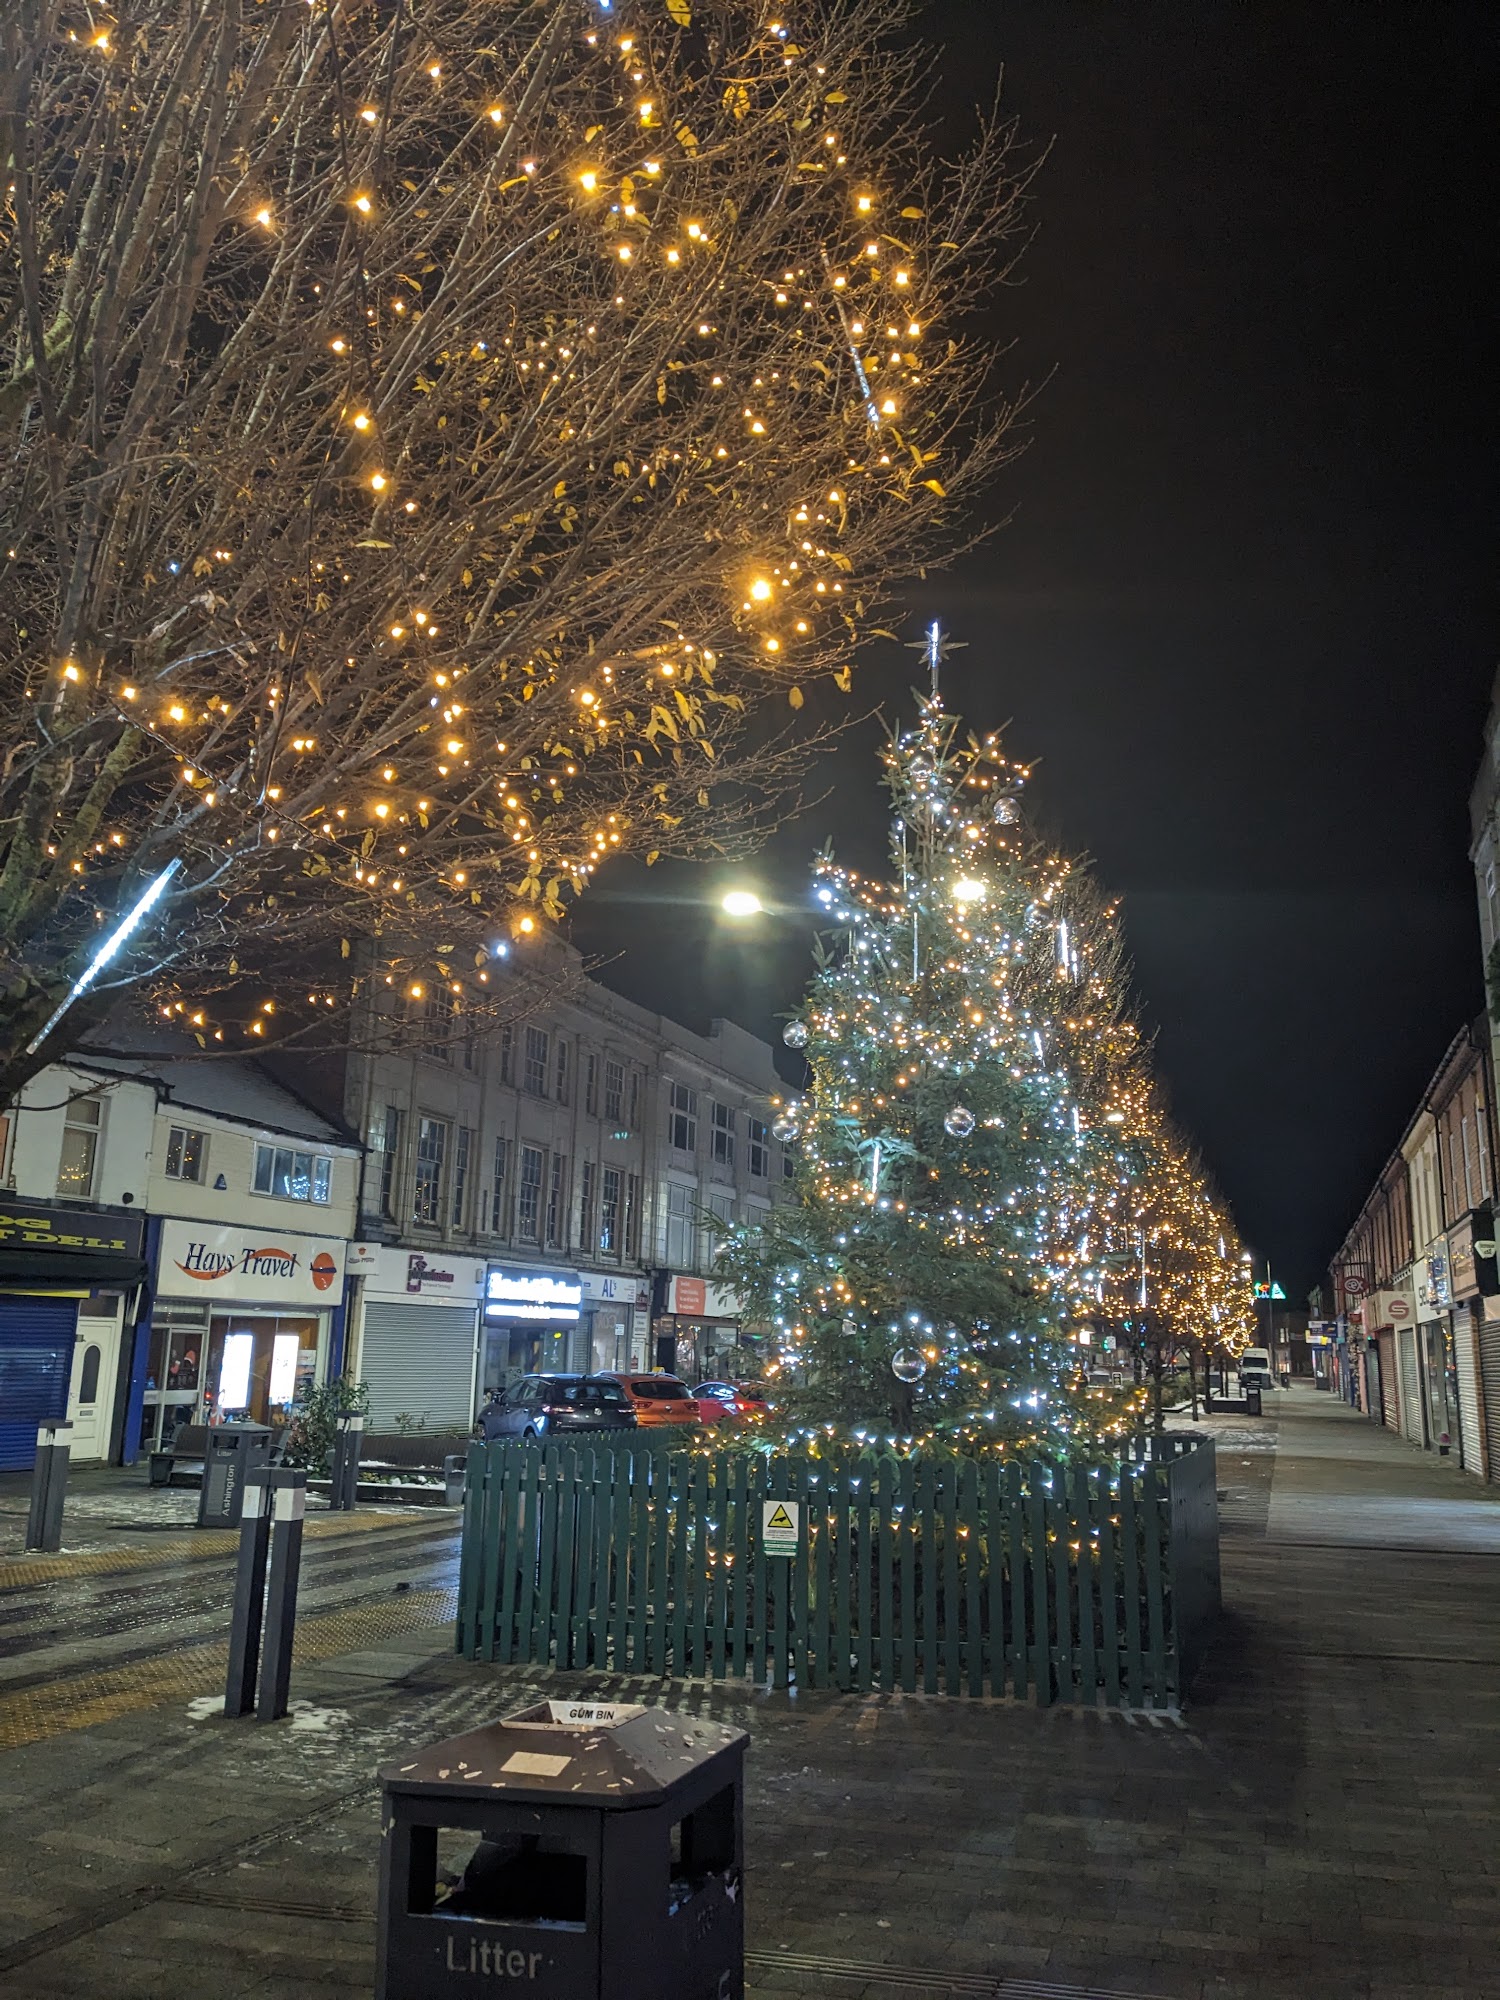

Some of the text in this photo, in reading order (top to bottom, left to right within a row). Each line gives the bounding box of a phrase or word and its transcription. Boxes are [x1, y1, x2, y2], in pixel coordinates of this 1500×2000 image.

[22, 1231, 126, 1250] DELI
[183, 1242, 297, 1279] Hays Travel
[221, 1464, 236, 1517] Ashington
[596, 1710, 615, 1720] BIN
[447, 1936, 543, 1979] Litter
